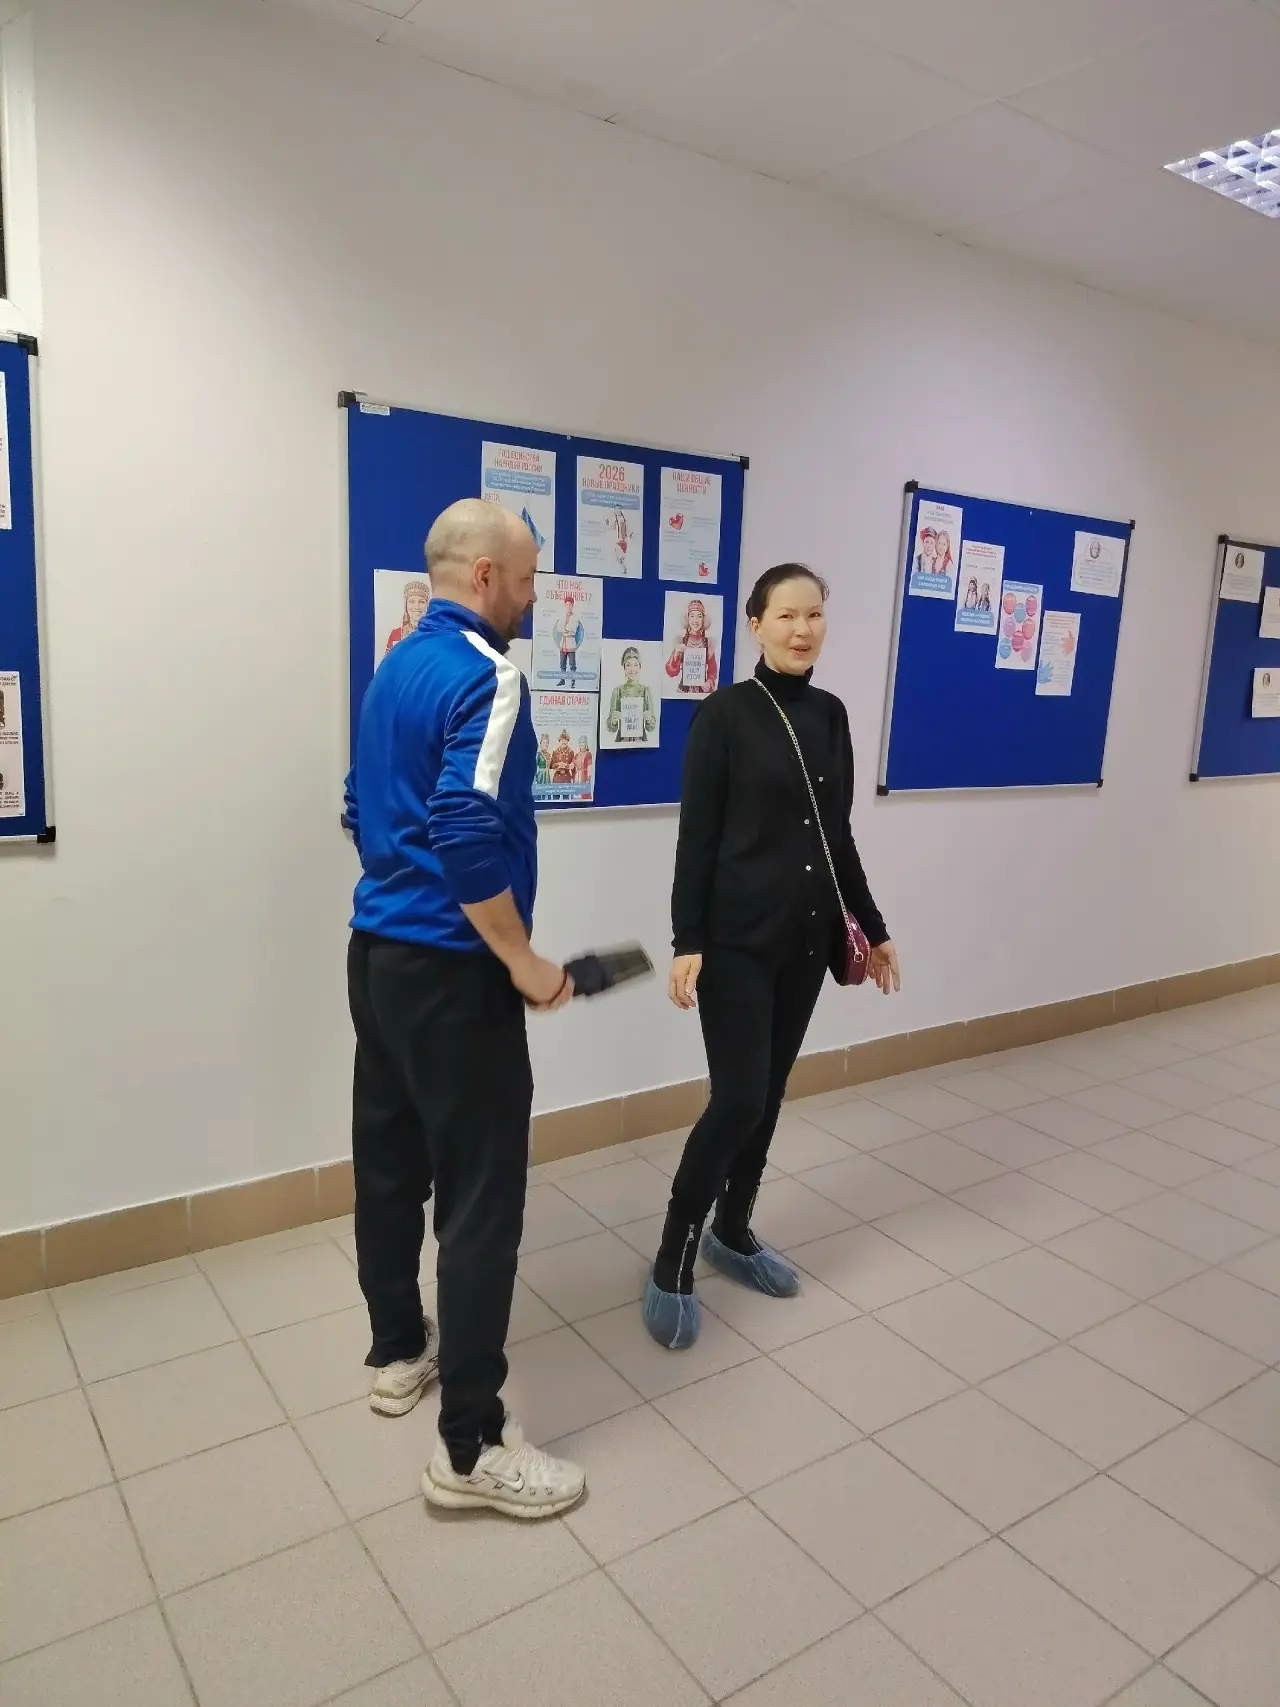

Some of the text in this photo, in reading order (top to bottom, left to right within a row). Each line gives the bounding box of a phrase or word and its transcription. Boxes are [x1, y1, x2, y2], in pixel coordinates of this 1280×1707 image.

[511, 450, 540, 462] ЕДИНСТВА
[494, 457, 544, 473] НАРОДОВ РОССИИ
[599, 464, 625, 482] 2026
[672, 471, 691, 483] НАШИ
[582, 477, 640, 494] НОВЫЕ ПРАЗДНИКИ
[676, 482, 707, 495] ЦЕННОСТИ
[557, 579, 583, 591] ЧТО НАС
[539, 695, 590, 706] ЕДИНАЯ СТРАНА
